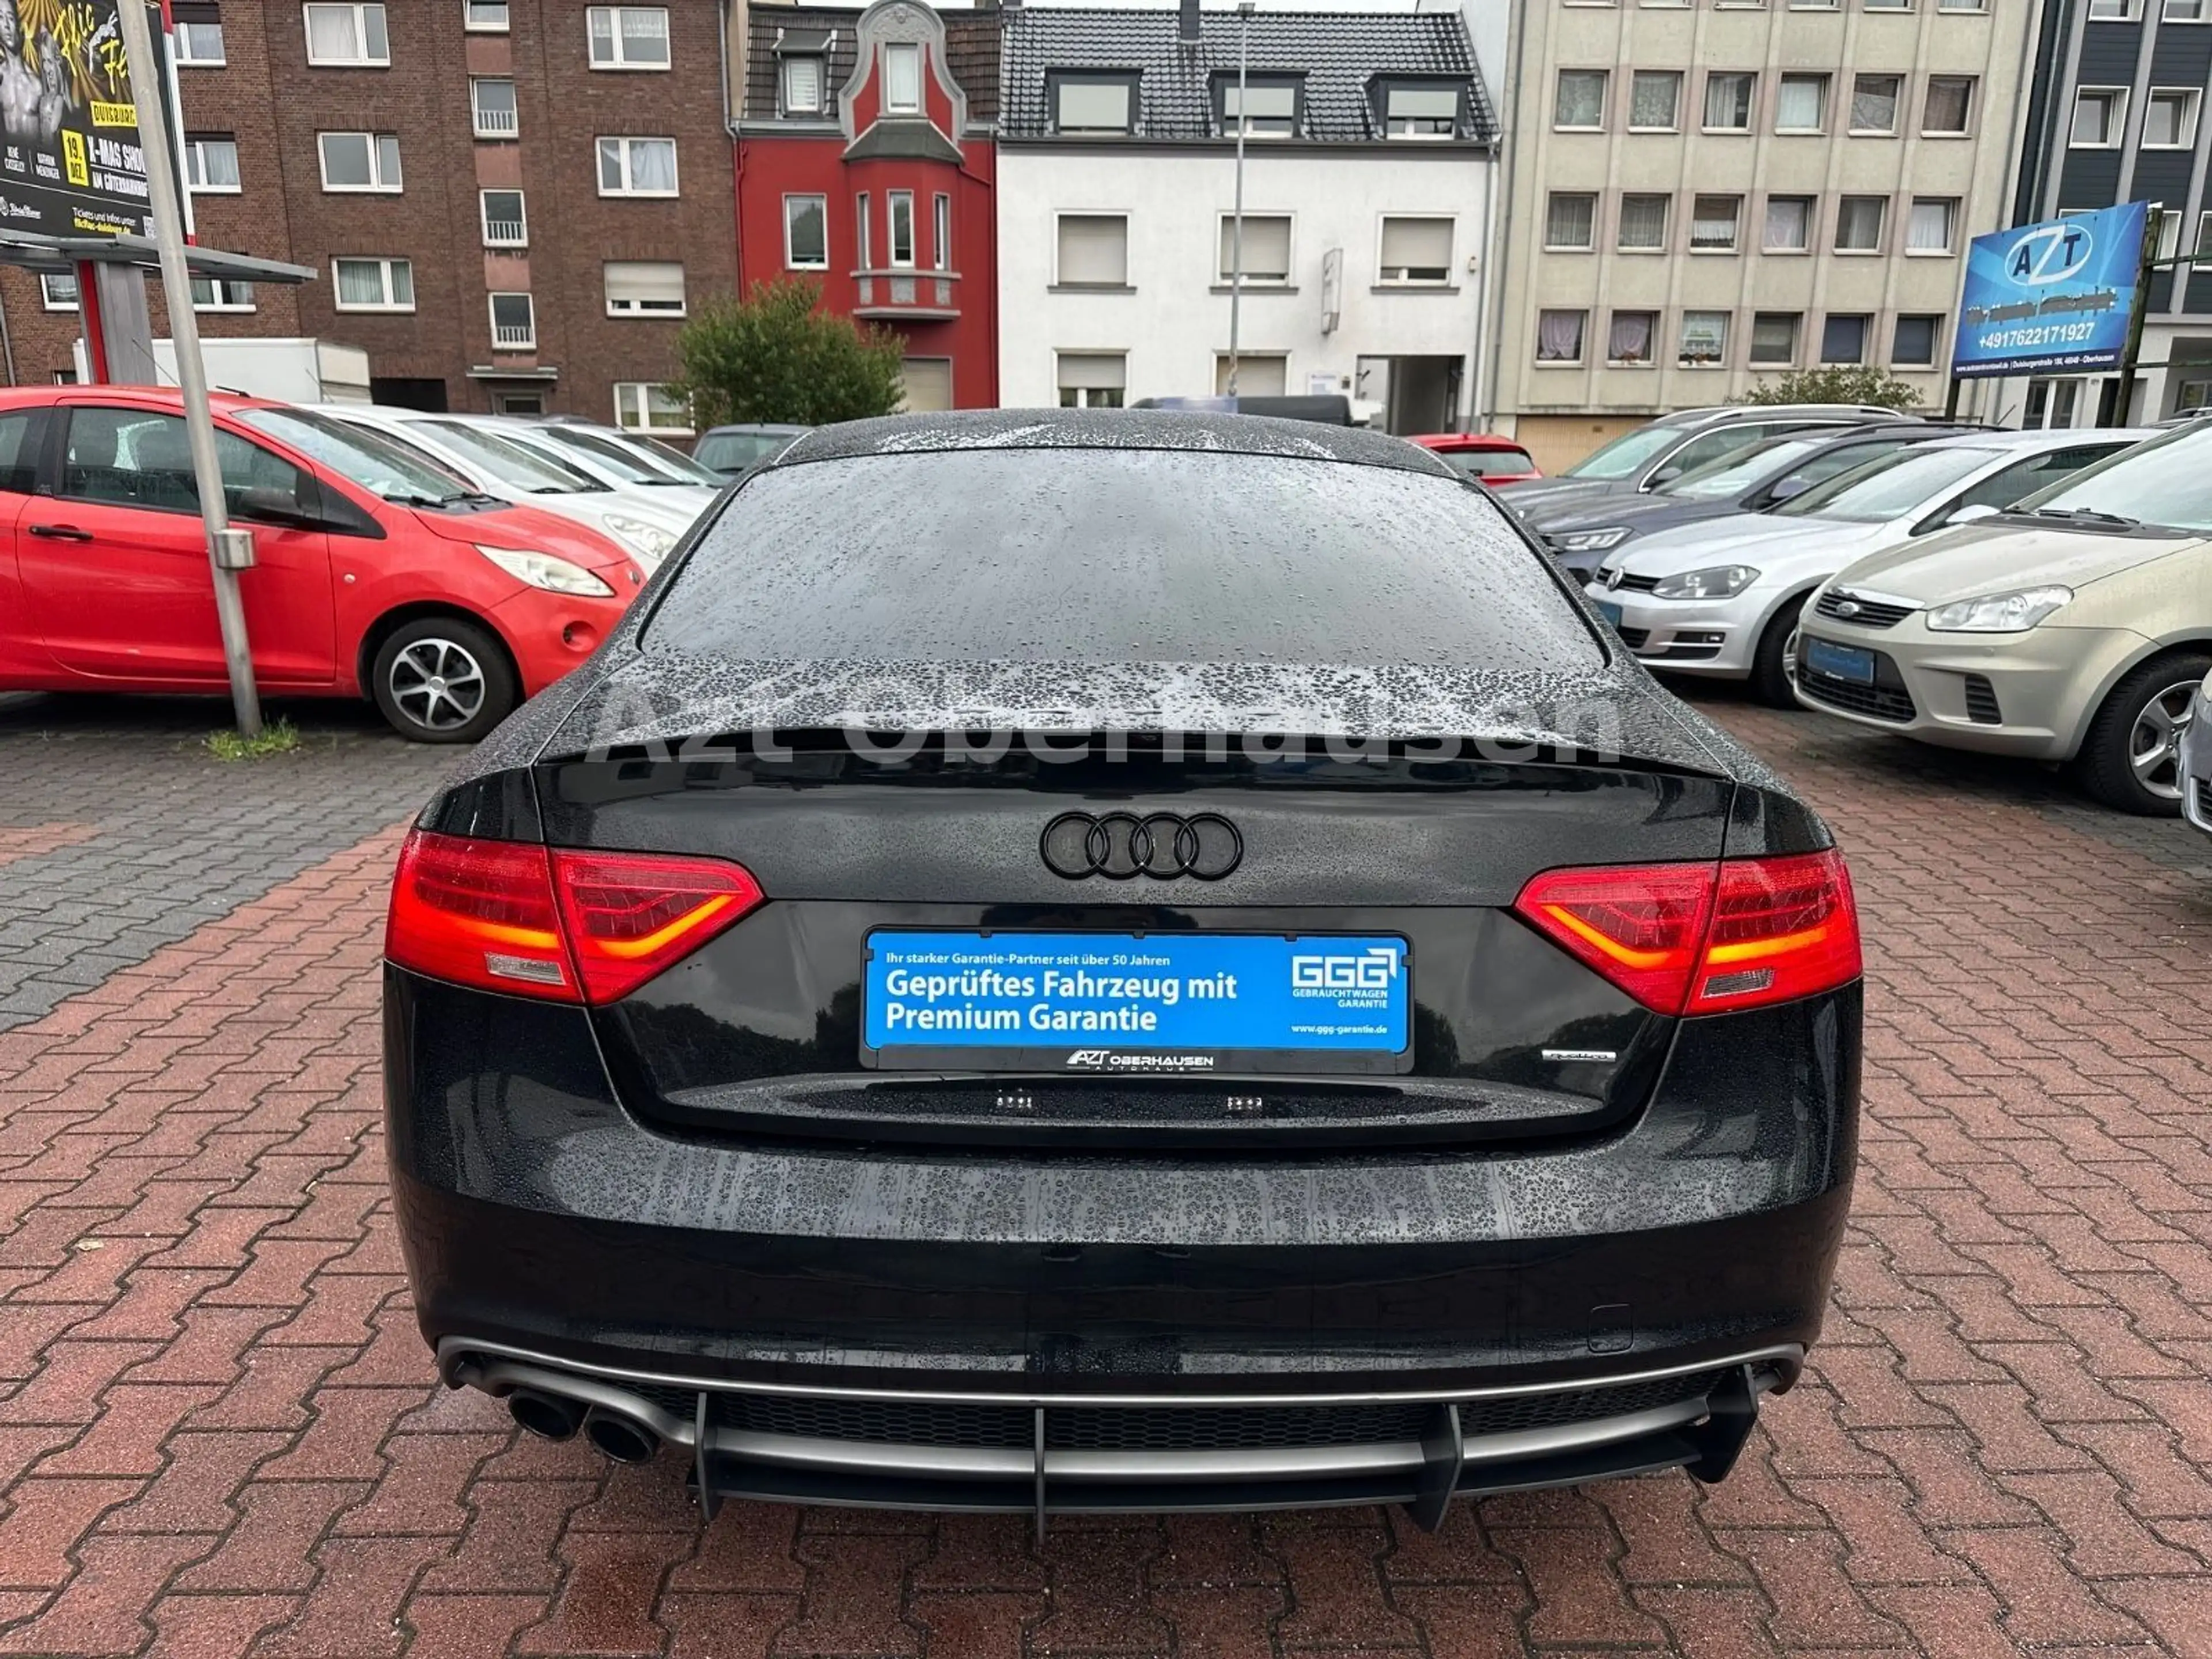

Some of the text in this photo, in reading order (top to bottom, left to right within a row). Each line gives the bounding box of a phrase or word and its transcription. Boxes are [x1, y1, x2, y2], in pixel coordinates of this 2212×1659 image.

[67, 137, 82, 161] 19.
[87, 135, 122, 168] X-MAS
[2013, 225, 2082, 285] AZT
[1979, 322, 2096, 350] +4917622171927
[887, 953, 1171, 967] Ihr starker Garantie-Partner seit über 50 Jahren
[1292, 956, 1388, 988] GGG
[887, 969, 1237, 1005] Geprüftes Fahrzeug mit
[1292, 988, 1388, 999] GEBRAUCHTWAGEN
[1338, 999, 1388, 1009] GARANTIE
[887, 1003, 1157, 1032] Premium Garantie
[1291, 1024, 1388, 1035] www.ggg-garantie.de
[1067, 1050, 1214, 1066] AZT OBERHAUSEN
